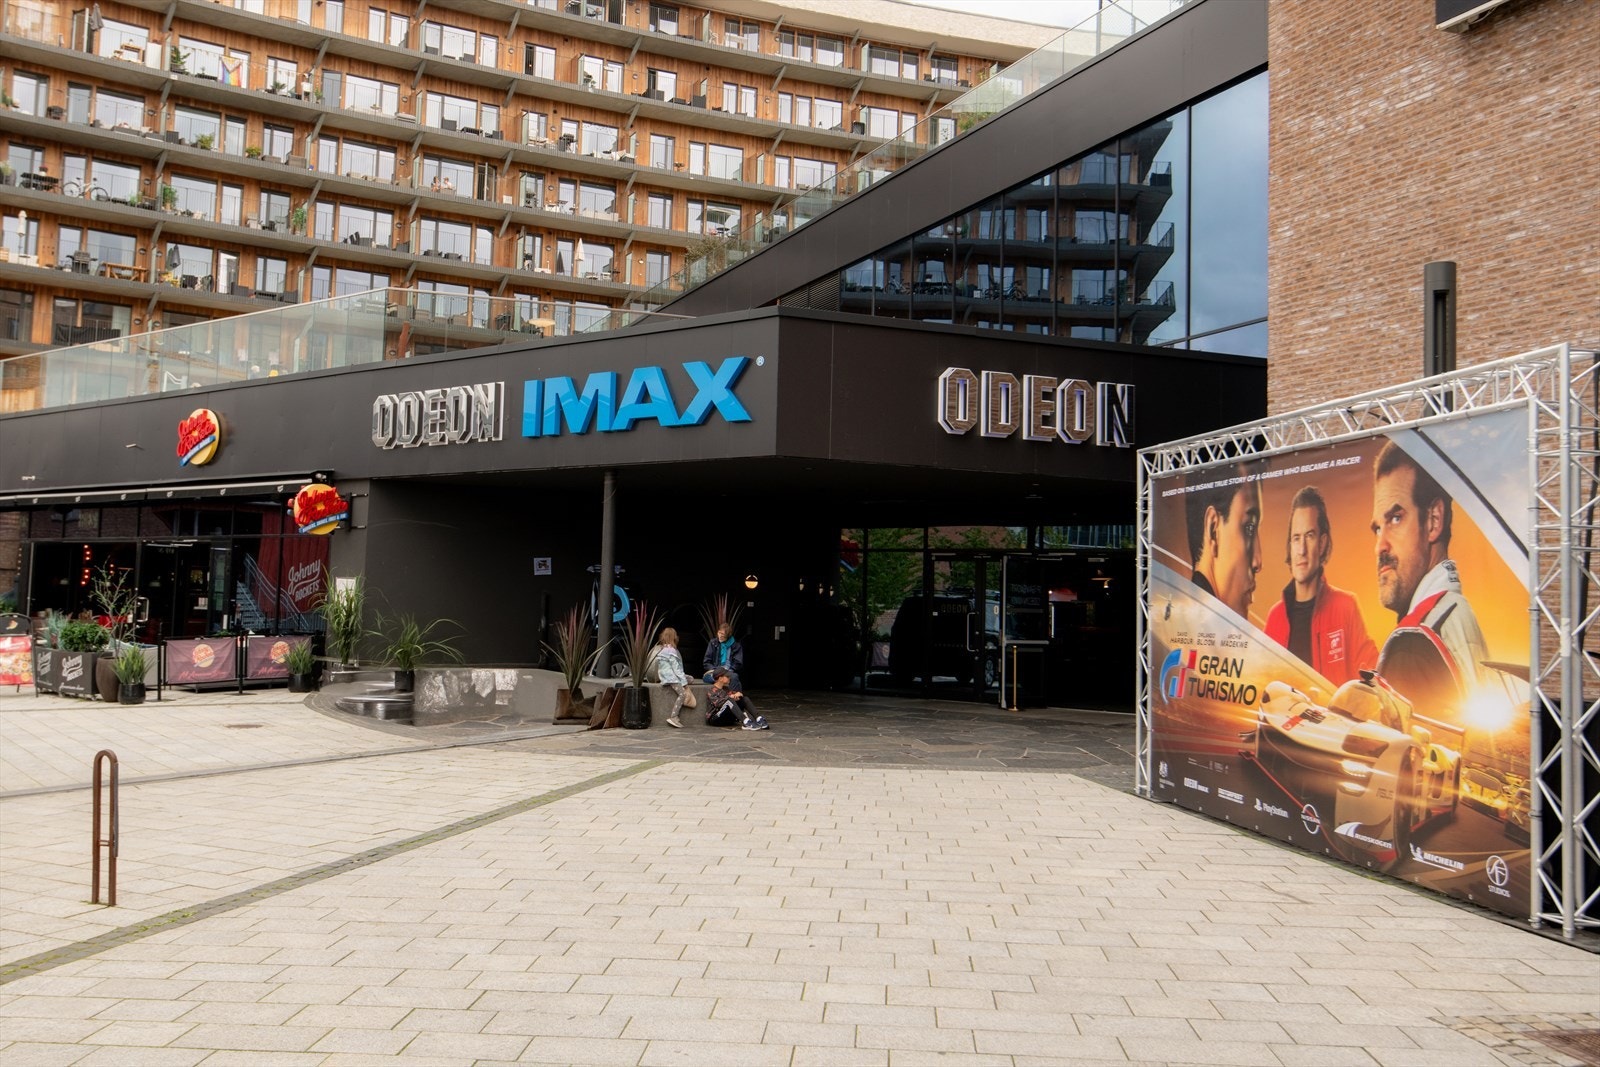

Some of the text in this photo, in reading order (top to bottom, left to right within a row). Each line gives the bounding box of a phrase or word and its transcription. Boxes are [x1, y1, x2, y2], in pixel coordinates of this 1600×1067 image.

[372, 356, 752, 449] ODEON IMAX
[938, 367, 1136, 448] ODEON
[1185, 485, 1196, 493] THE
[1195, 481, 1214, 491] INSANE
[1214, 479, 1228, 488] TRUE
[1228, 476, 1247, 486] STORY
[1246, 473, 1257, 482] OF
[1261, 469, 1284, 480] GAMER
[1284, 466, 1300, 476] WHO
[1300, 461, 1329, 473] BECAME
[1329, 460, 1335, 468] A
[1336, 456, 1361, 467] RACER
[288, 559, 321, 590] Johnny
[295, 579, 321, 602] ROCKETS
[1199, 655, 1244, 678] GRAN
[1188, 677, 1257, 706] TURISMO
[1263, 802, 1289, 818] PlayStation
[1300, 814, 1321, 825] NISSAN
[1423, 852, 1465, 870] MICHELIN
[1487, 884, 1511, 898] STUDIOS
